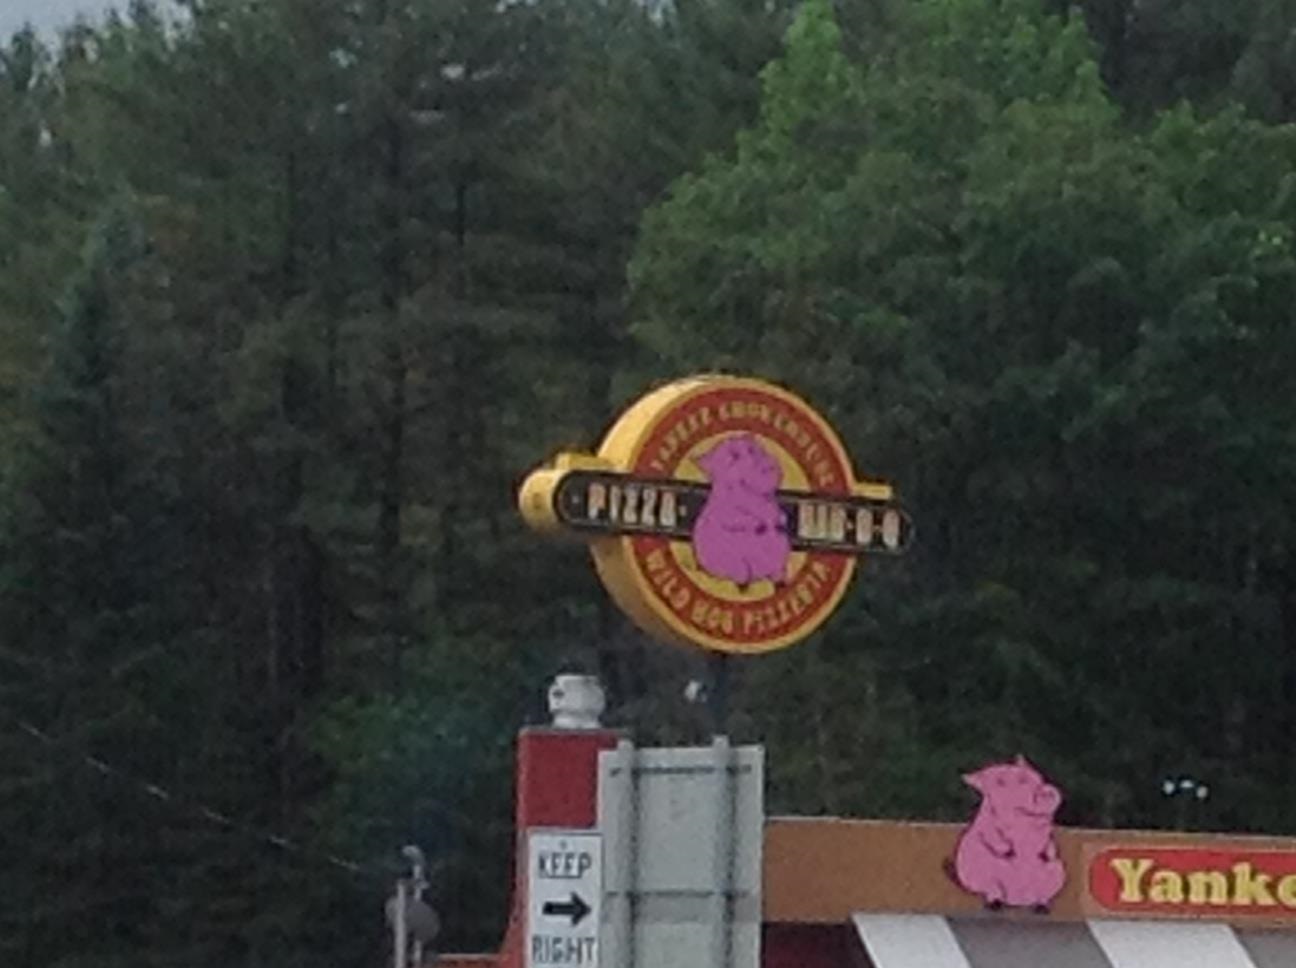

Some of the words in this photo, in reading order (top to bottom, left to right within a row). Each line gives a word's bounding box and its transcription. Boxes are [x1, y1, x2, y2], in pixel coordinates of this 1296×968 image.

[587, 481, 678, 527] PIZZA
[646, 549, 692, 610] WILD
[538, 852, 592, 879] KEEP
[532, 936, 596, 964] RIGHT
